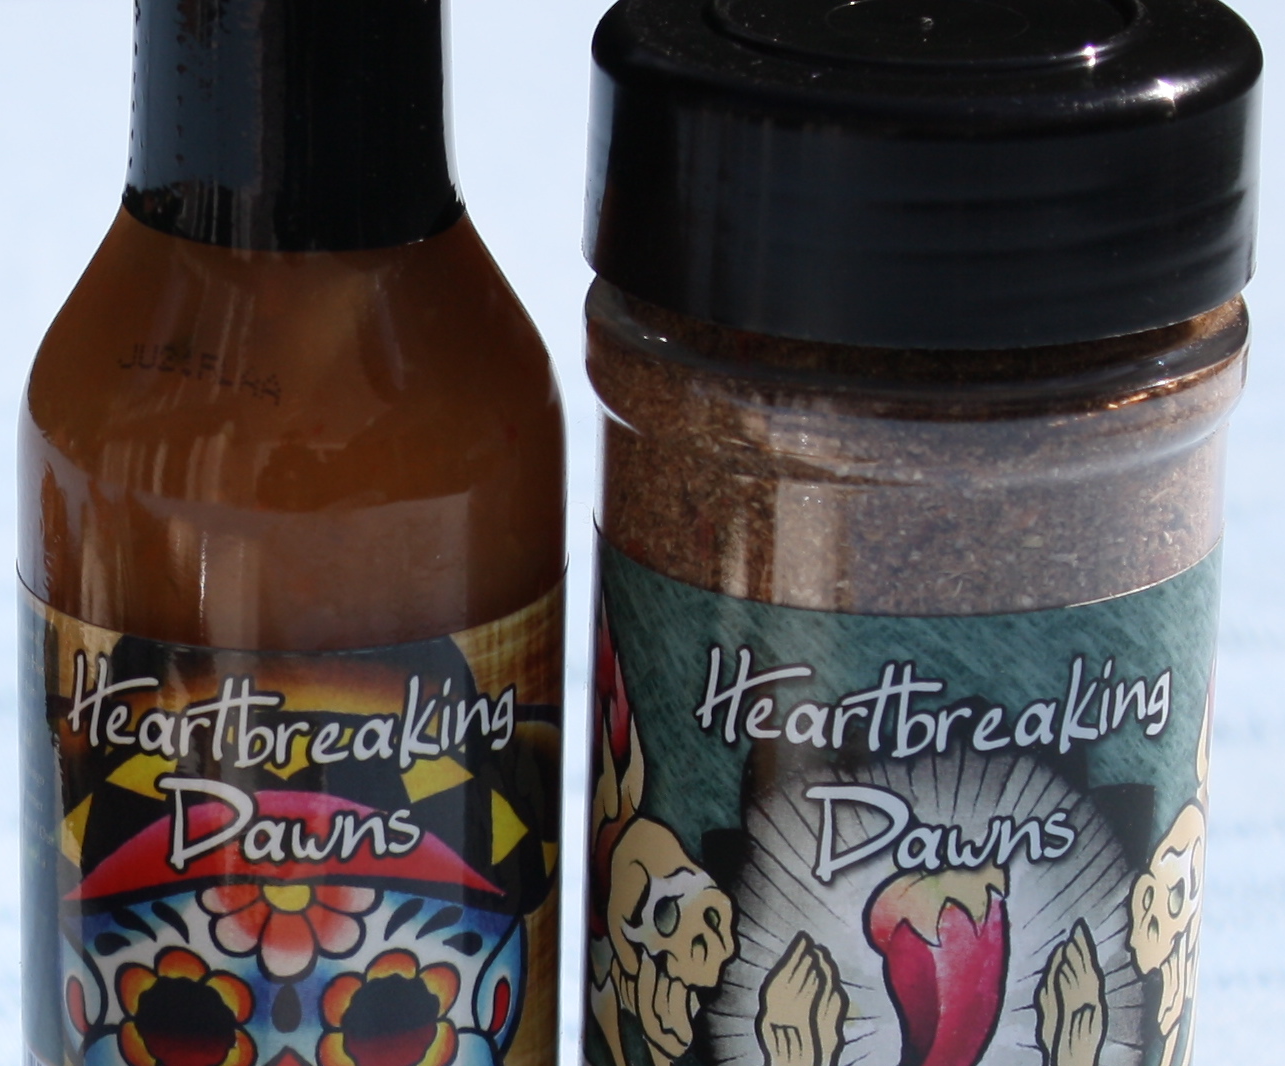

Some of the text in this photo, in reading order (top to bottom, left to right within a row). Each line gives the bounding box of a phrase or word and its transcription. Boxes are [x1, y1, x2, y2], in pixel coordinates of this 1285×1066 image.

[67, 654, 515, 769] Heartbreaking
[695, 646, 1172, 759] Heartbreaking
[158, 776, 420, 869] Dawns
[805, 784, 1076, 883] Dawns
